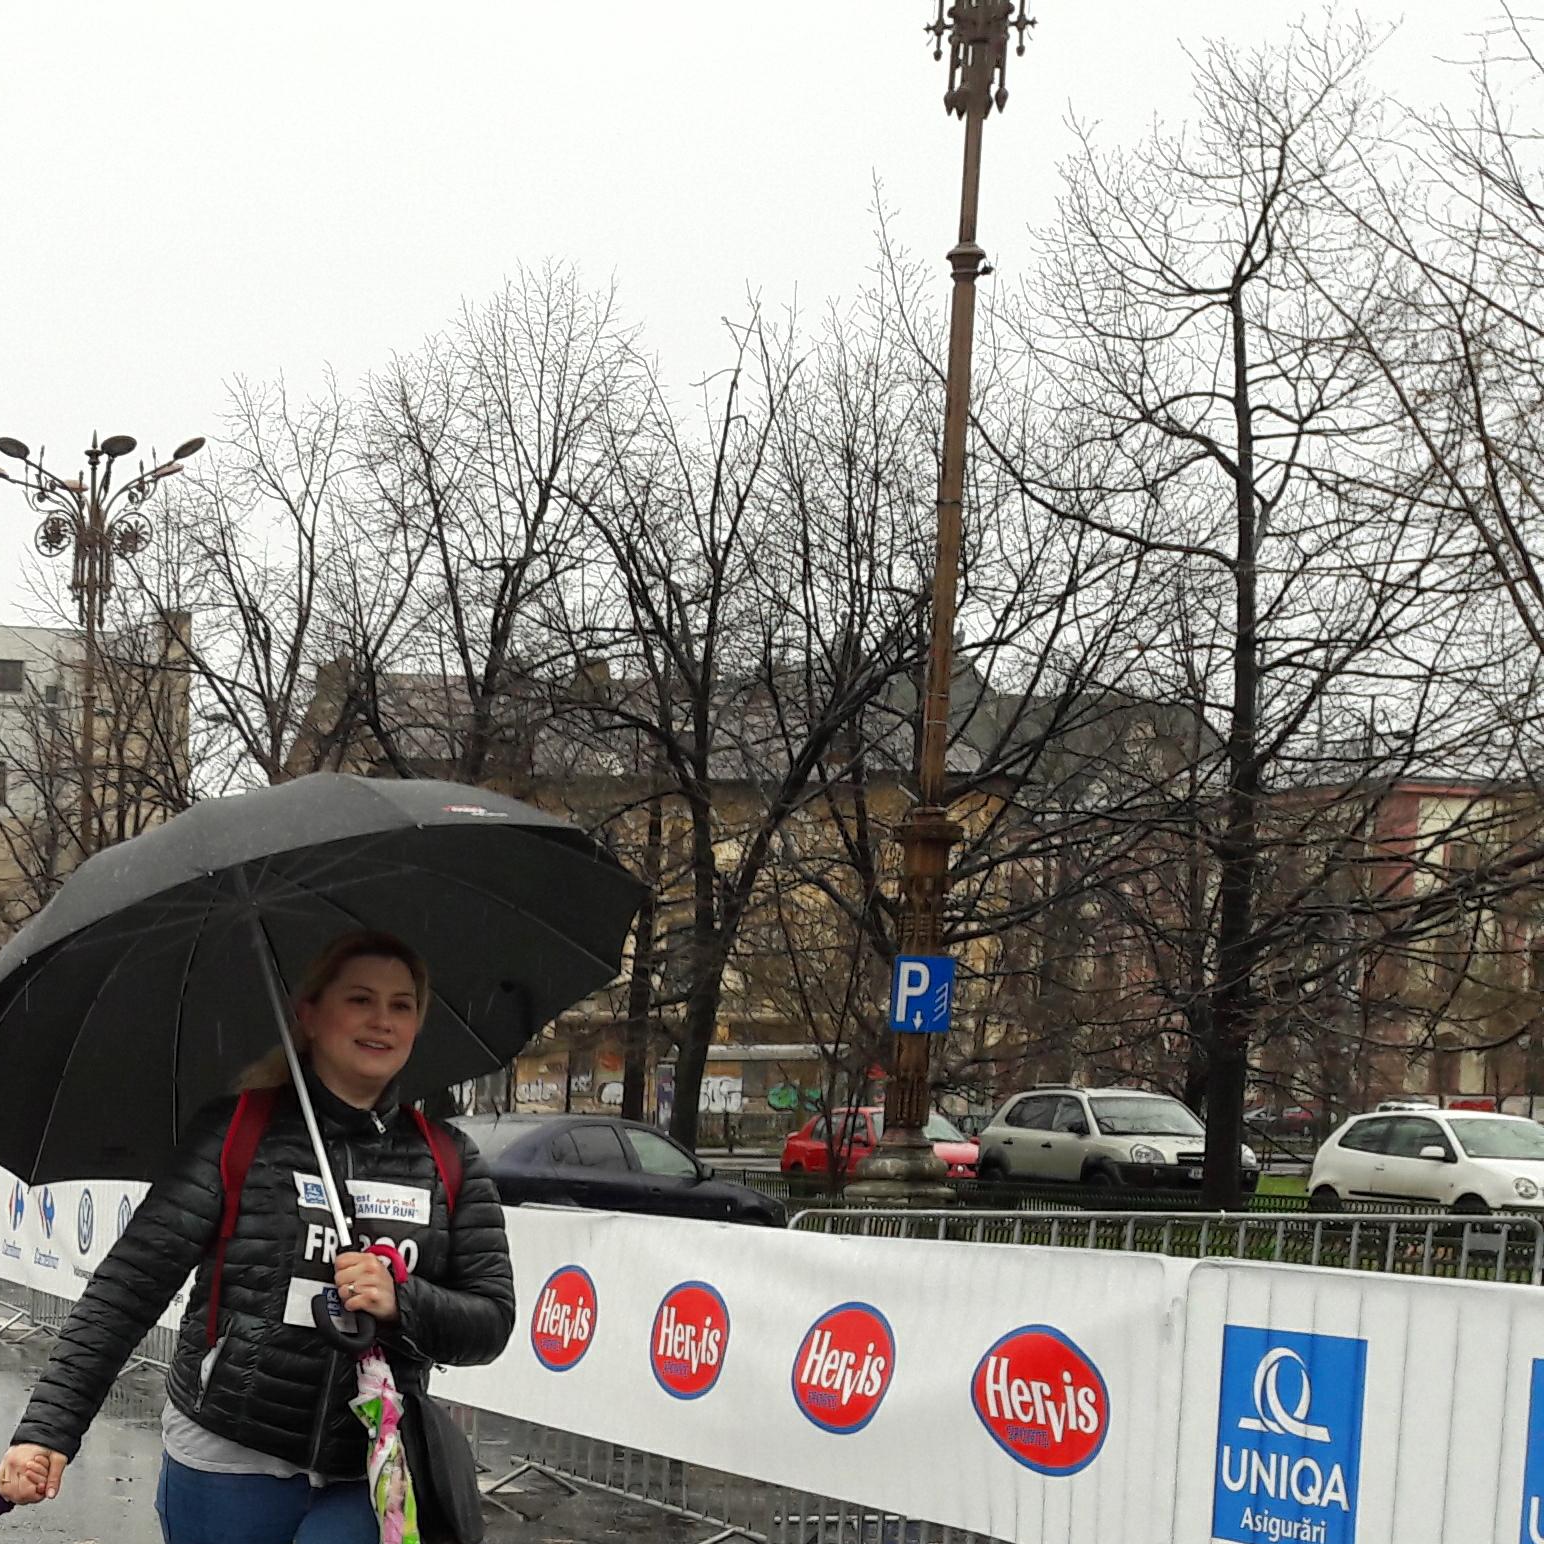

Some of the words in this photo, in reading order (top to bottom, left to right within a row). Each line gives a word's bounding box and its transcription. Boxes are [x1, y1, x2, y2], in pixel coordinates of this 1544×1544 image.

[896, 961, 930, 1022] P
[536, 1287, 591, 1349] Hervis
[657, 1305, 721, 1374] Hervis
[800, 1329, 886, 1406] Hervis
[985, 1355, 1099, 1443] Hervis
[1222, 1445, 1351, 1512] UNIQA
[1240, 1507, 1328, 1544] Asigurări
